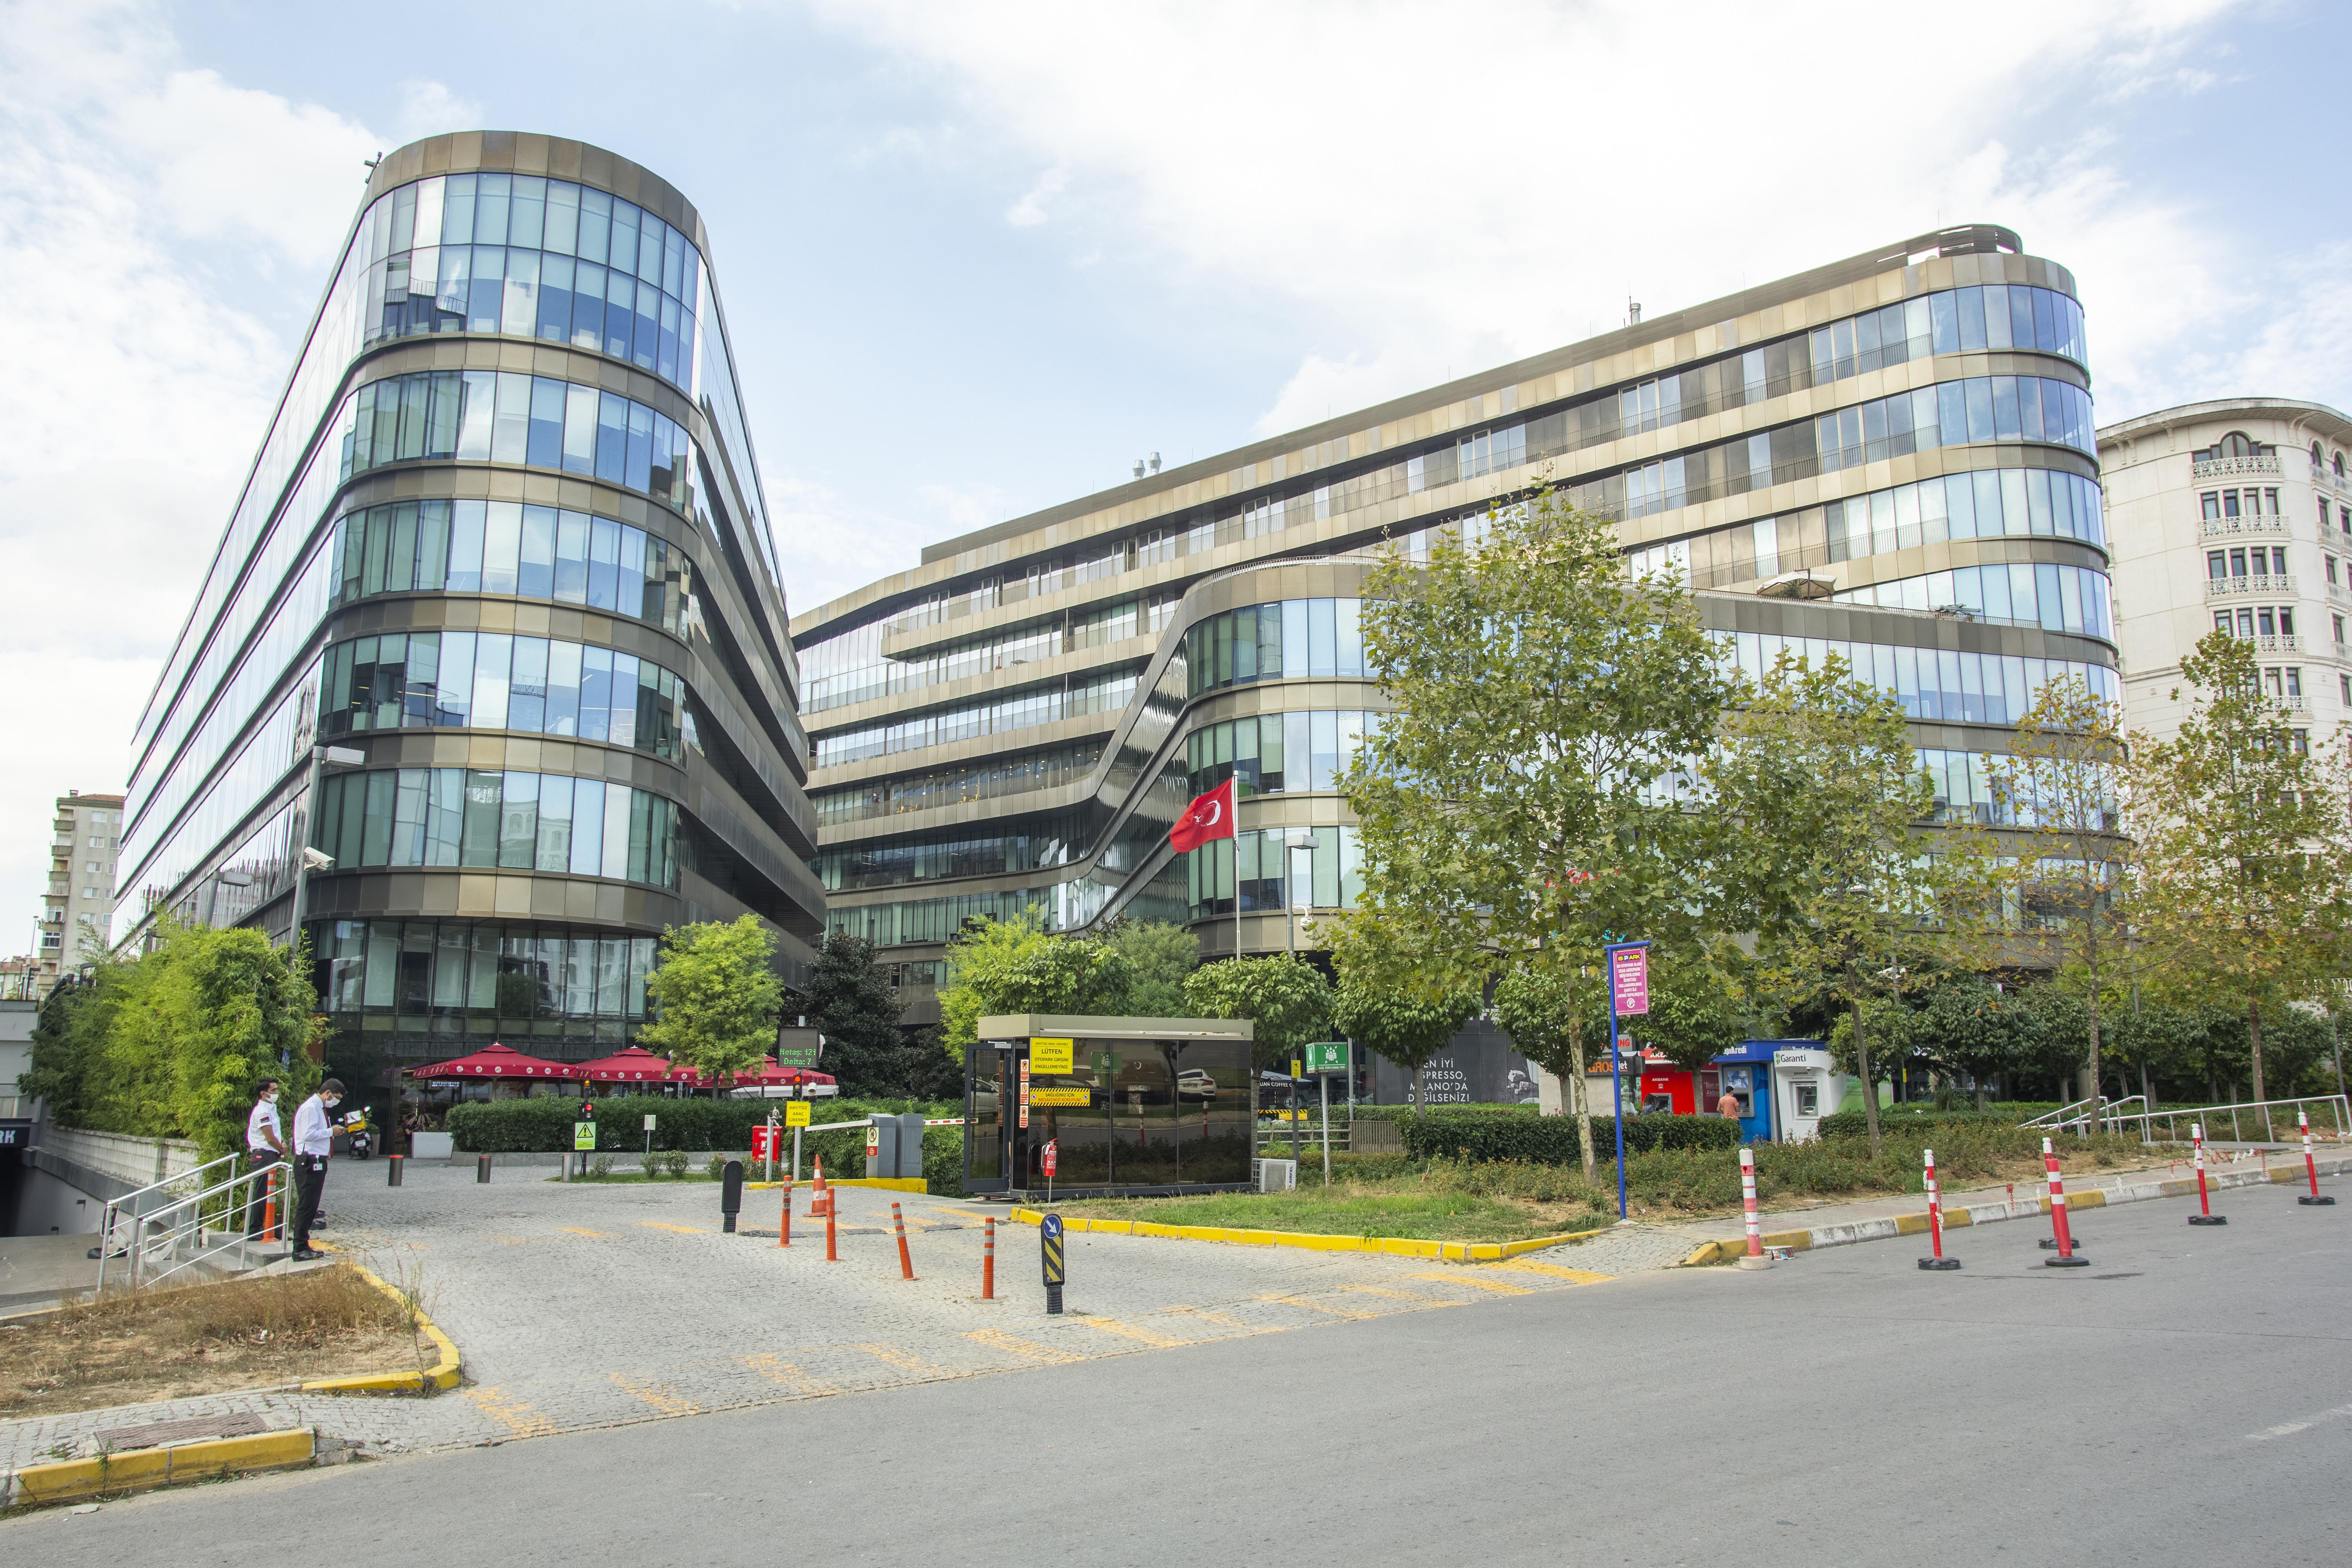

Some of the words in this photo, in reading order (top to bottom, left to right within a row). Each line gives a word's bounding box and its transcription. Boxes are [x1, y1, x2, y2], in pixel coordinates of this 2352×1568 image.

[1617, 1038, 1630, 1047] ING
[780, 1048, 802, 1057] Netaş:
[1441, 1058, 1453, 1068] İYİ
[1618, 1060, 1627, 1071] jet
[1423, 1071, 1466, 1081] SPRESSO,
[1408, 1092, 1469, 1102] DĞİLSENİZ!
